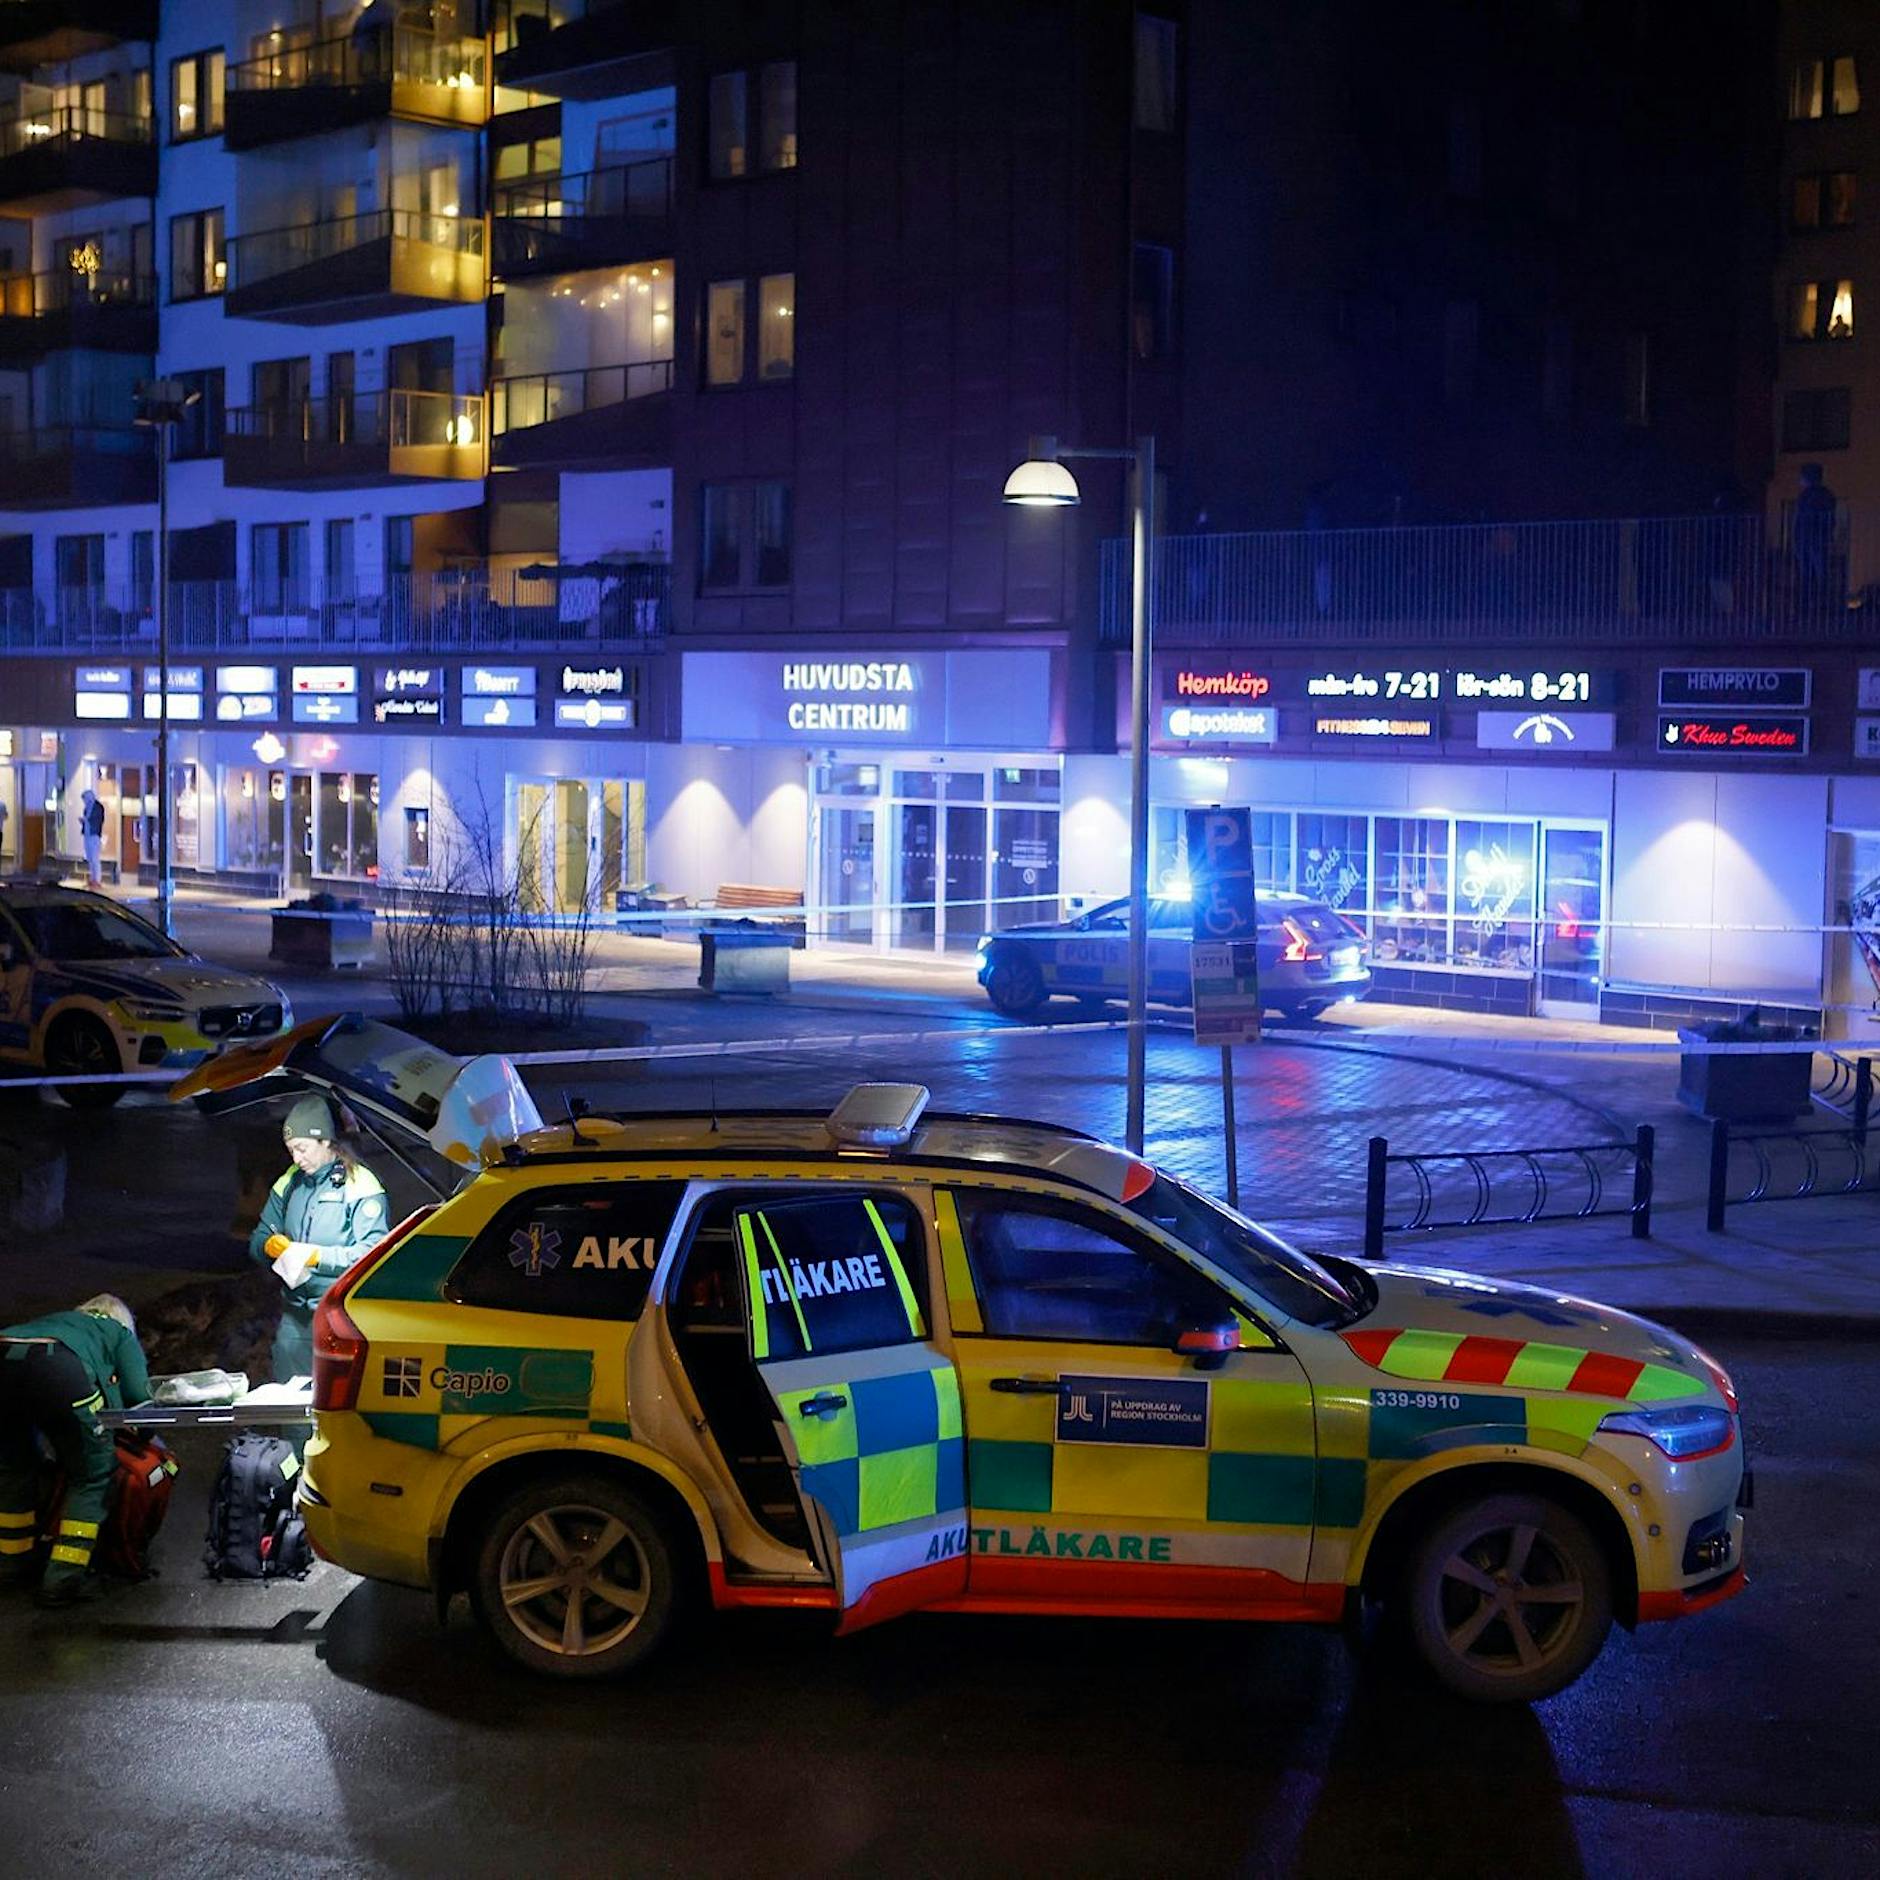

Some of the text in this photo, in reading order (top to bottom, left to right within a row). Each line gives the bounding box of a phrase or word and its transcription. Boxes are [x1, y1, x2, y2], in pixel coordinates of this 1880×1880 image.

[783, 663, 914, 691] HUVUDSTA
[1177, 671, 1269, 699] Hemköp
[1385, 671, 1440, 698] 7-21
[1530, 672, 1590, 701] 8-21
[788, 704, 907, 731] CENTRUM
[1729, 723, 1797, 746] Sweden
[430, 1366, 511, 1399] Capio
[1111, 1399, 1182, 1412] PÅ UPPDRAG AV
[1376, 1391, 1461, 1410] 339-9910
[1111, 1410, 1203, 1422] REGION STOCKHOLM
